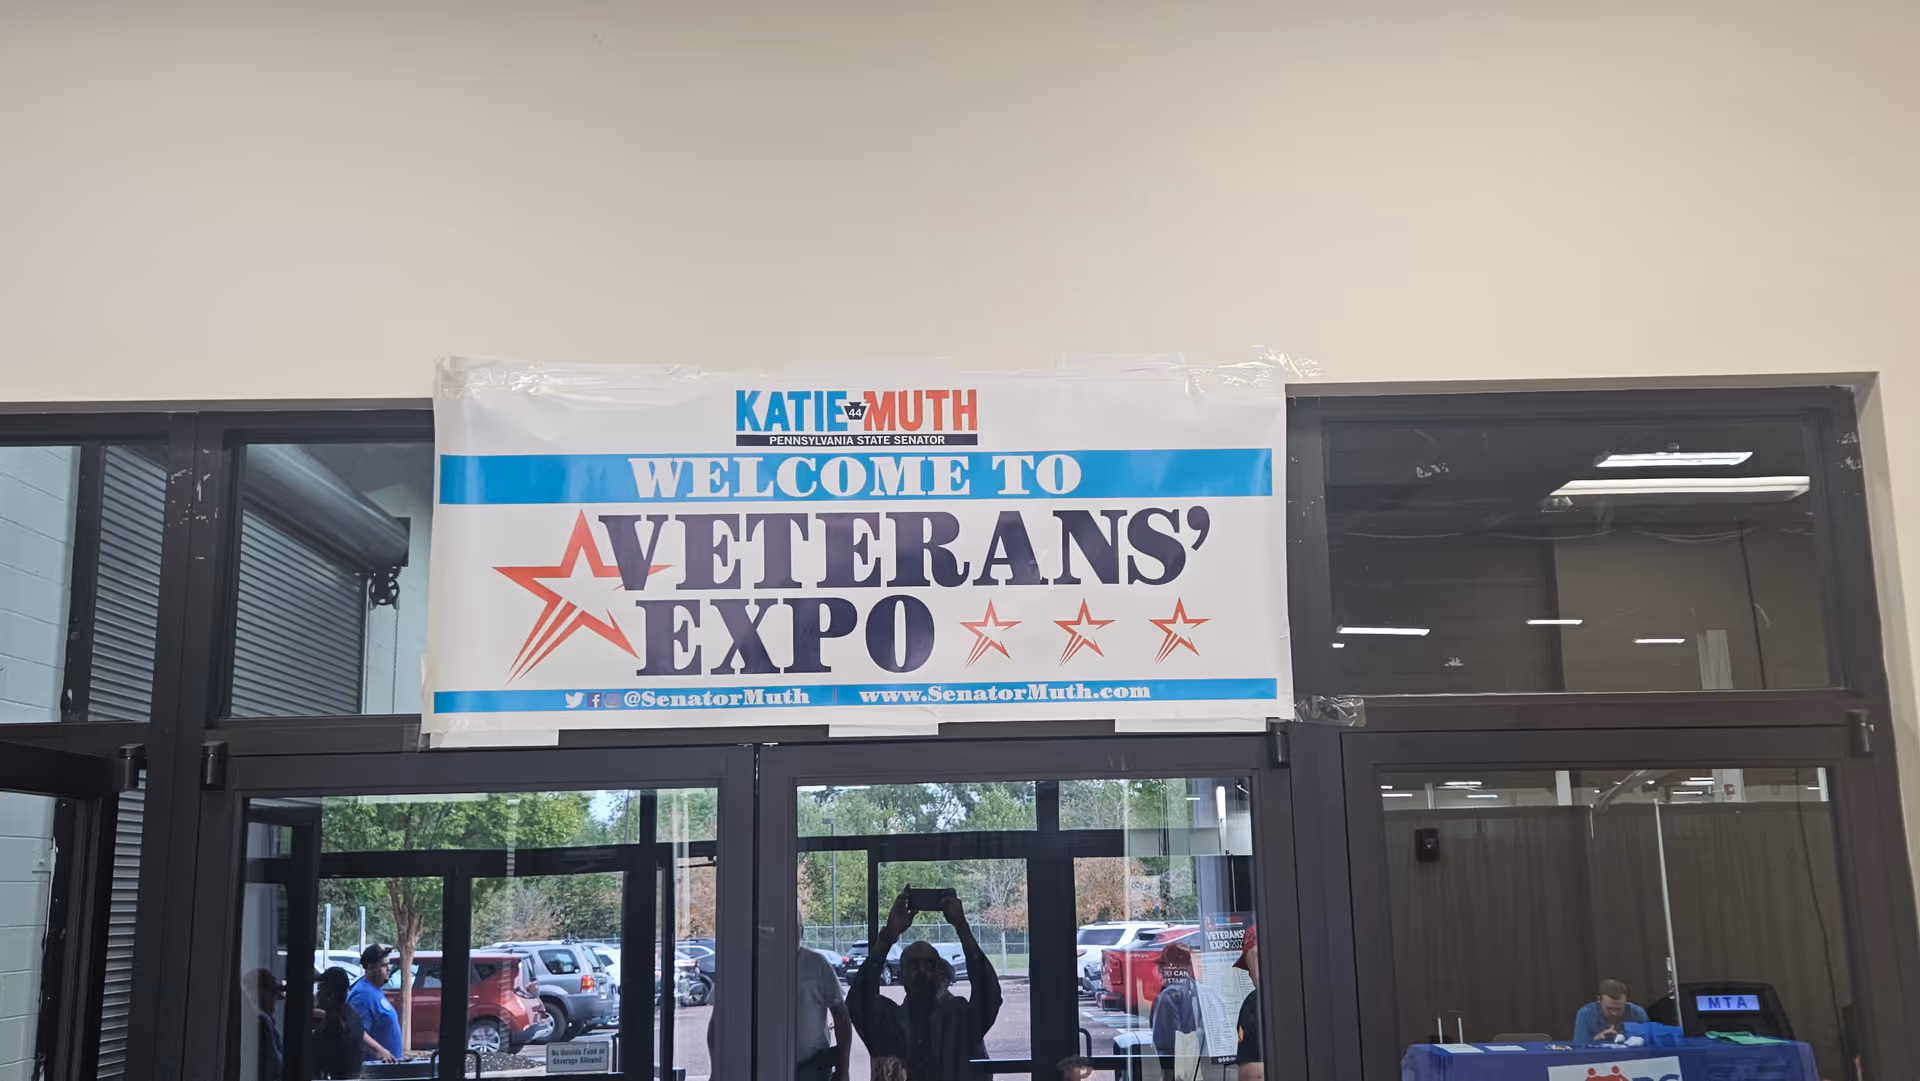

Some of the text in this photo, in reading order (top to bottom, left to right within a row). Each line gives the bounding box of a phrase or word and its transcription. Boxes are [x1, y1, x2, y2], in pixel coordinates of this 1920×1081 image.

[736, 389, 977, 432] KATIE 44 MUTH
[769, 435, 946, 446] PENNSYLVANIA STATE SENATOR
[628, 453, 1082, 499] WELCOME TO
[598, 505, 1211, 591] VETERANS'
[636, 593, 936, 676] EXPO
[624, 688, 810, 707] @SenatorMuth
[859, 683, 1151, 703] www.SenatorMuth.com
[1210, 940, 1230, 950] EXPO
[1708, 996, 1748, 1009] MTA
